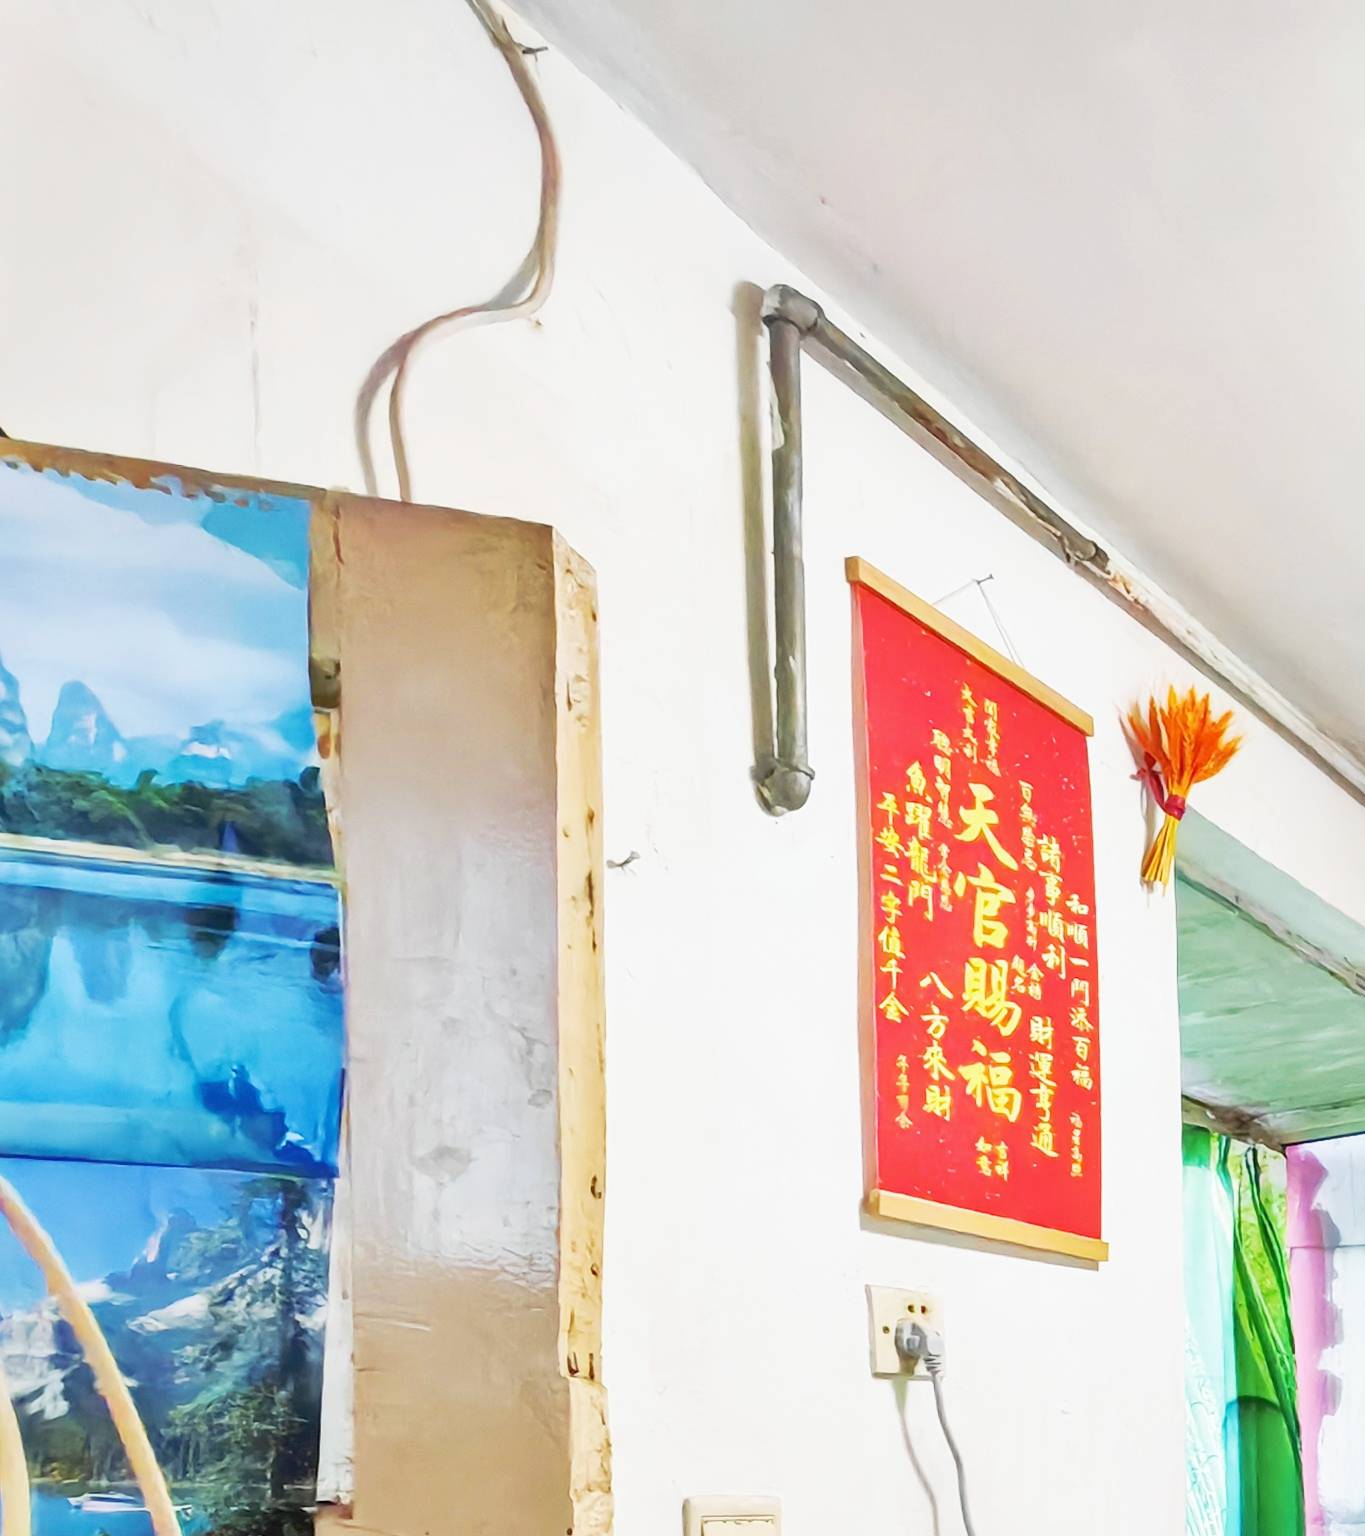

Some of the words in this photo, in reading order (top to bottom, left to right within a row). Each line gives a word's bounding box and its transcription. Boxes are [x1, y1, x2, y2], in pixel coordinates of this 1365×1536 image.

[874, 792, 910, 1023] 平安二字值千金
[904, 761, 937, 921] 魚躍龍門
[1036, 832, 1067, 980] 諸事順利
[954, 782, 1023, 1123] 天官賜福
[920, 971, 956, 1122] 八方來財
[1028, 1016, 1059, 1158] 財運亨通
